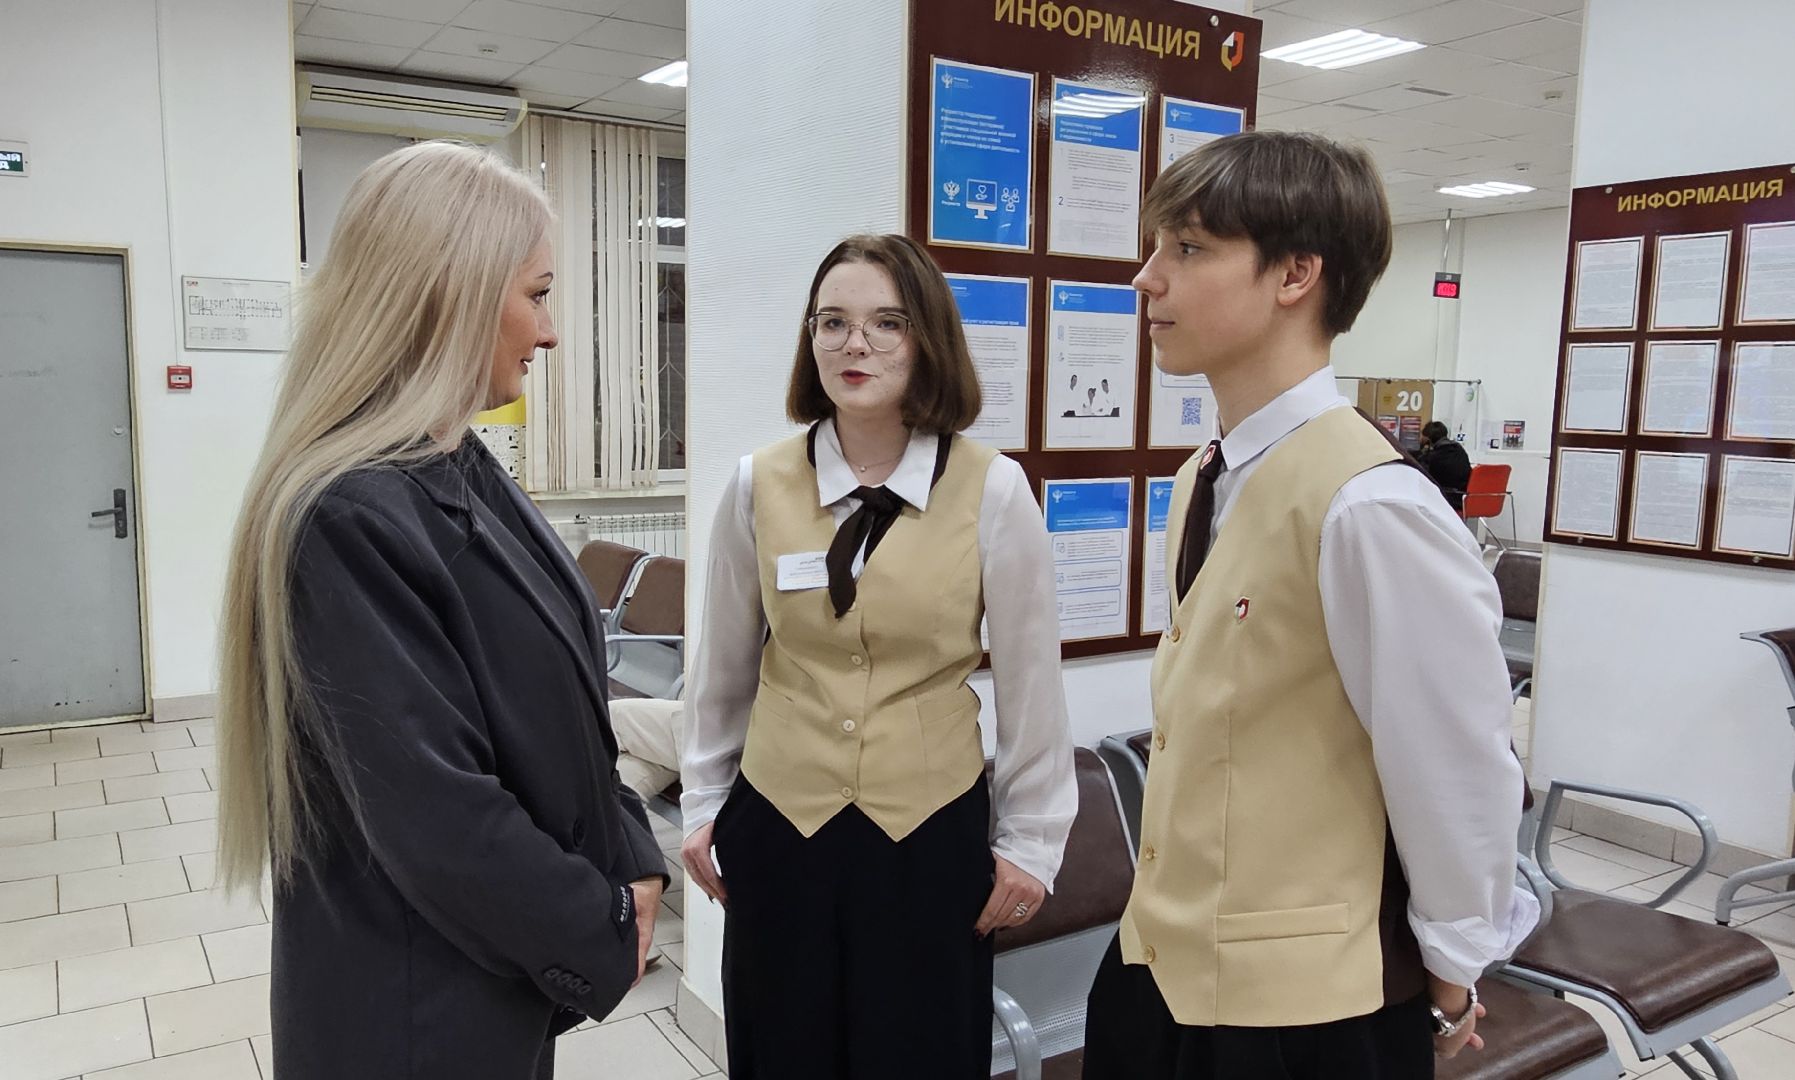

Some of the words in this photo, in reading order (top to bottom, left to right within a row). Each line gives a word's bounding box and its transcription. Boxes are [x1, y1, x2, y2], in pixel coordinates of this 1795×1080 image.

[995, 0, 1200, 59] ИНФОРМАЦИЯ
[1618, 179, 1783, 212] ИНФОРМАЦИЯ
[1397, 390, 1423, 411] 20
